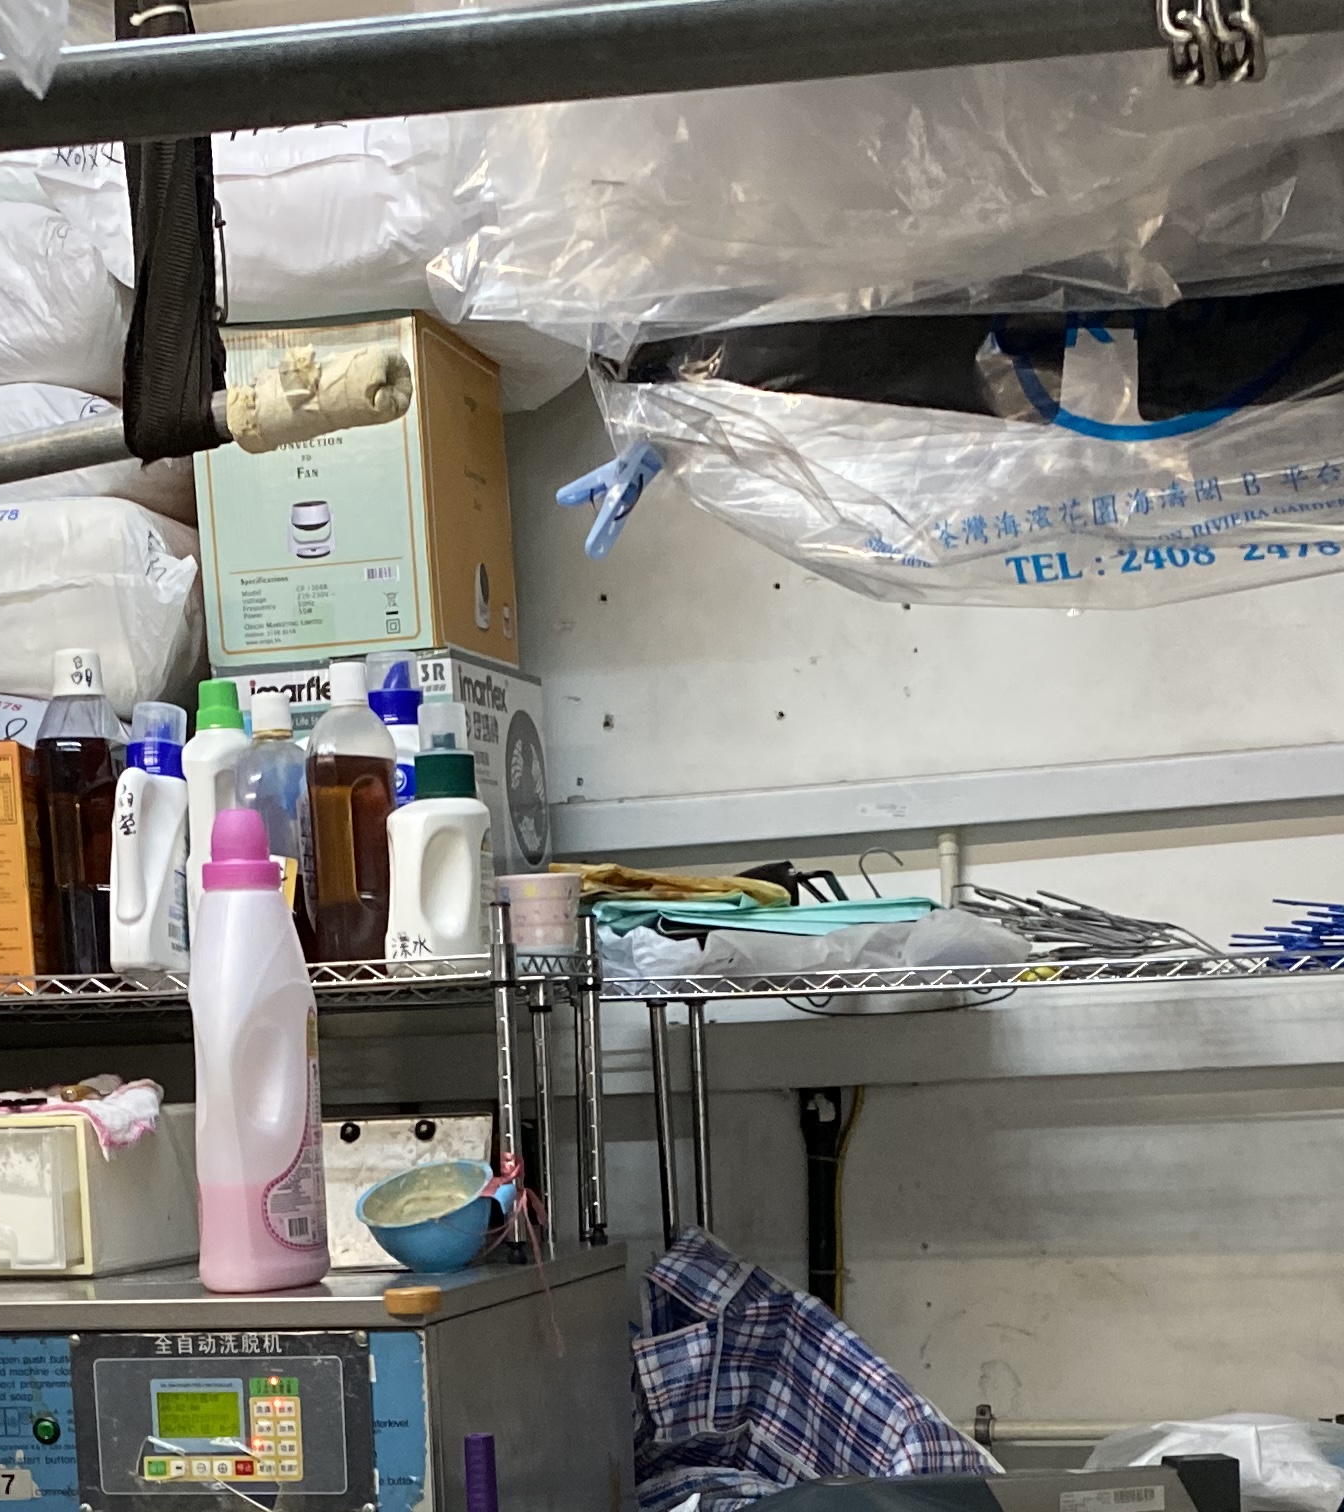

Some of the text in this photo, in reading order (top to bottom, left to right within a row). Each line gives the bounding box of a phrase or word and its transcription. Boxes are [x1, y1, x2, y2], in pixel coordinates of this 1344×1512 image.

[275, 436, 344, 451] ONVECTION
[1243, 472, 1262, 497] B
[1192, 507, 1270, 539] RIVIERA
[1119, 543, 1216, 574] 2408
[154, 1334, 283, 1355] 全自动洗脱机
[9, 1367, 50, 1377] machine
[20, 1379, 71, 1391] programm
[10, 1392, 34, 1403] soap
[45, 1455, 76, 1465] button
[1, 1474, 15, 1495] 7
